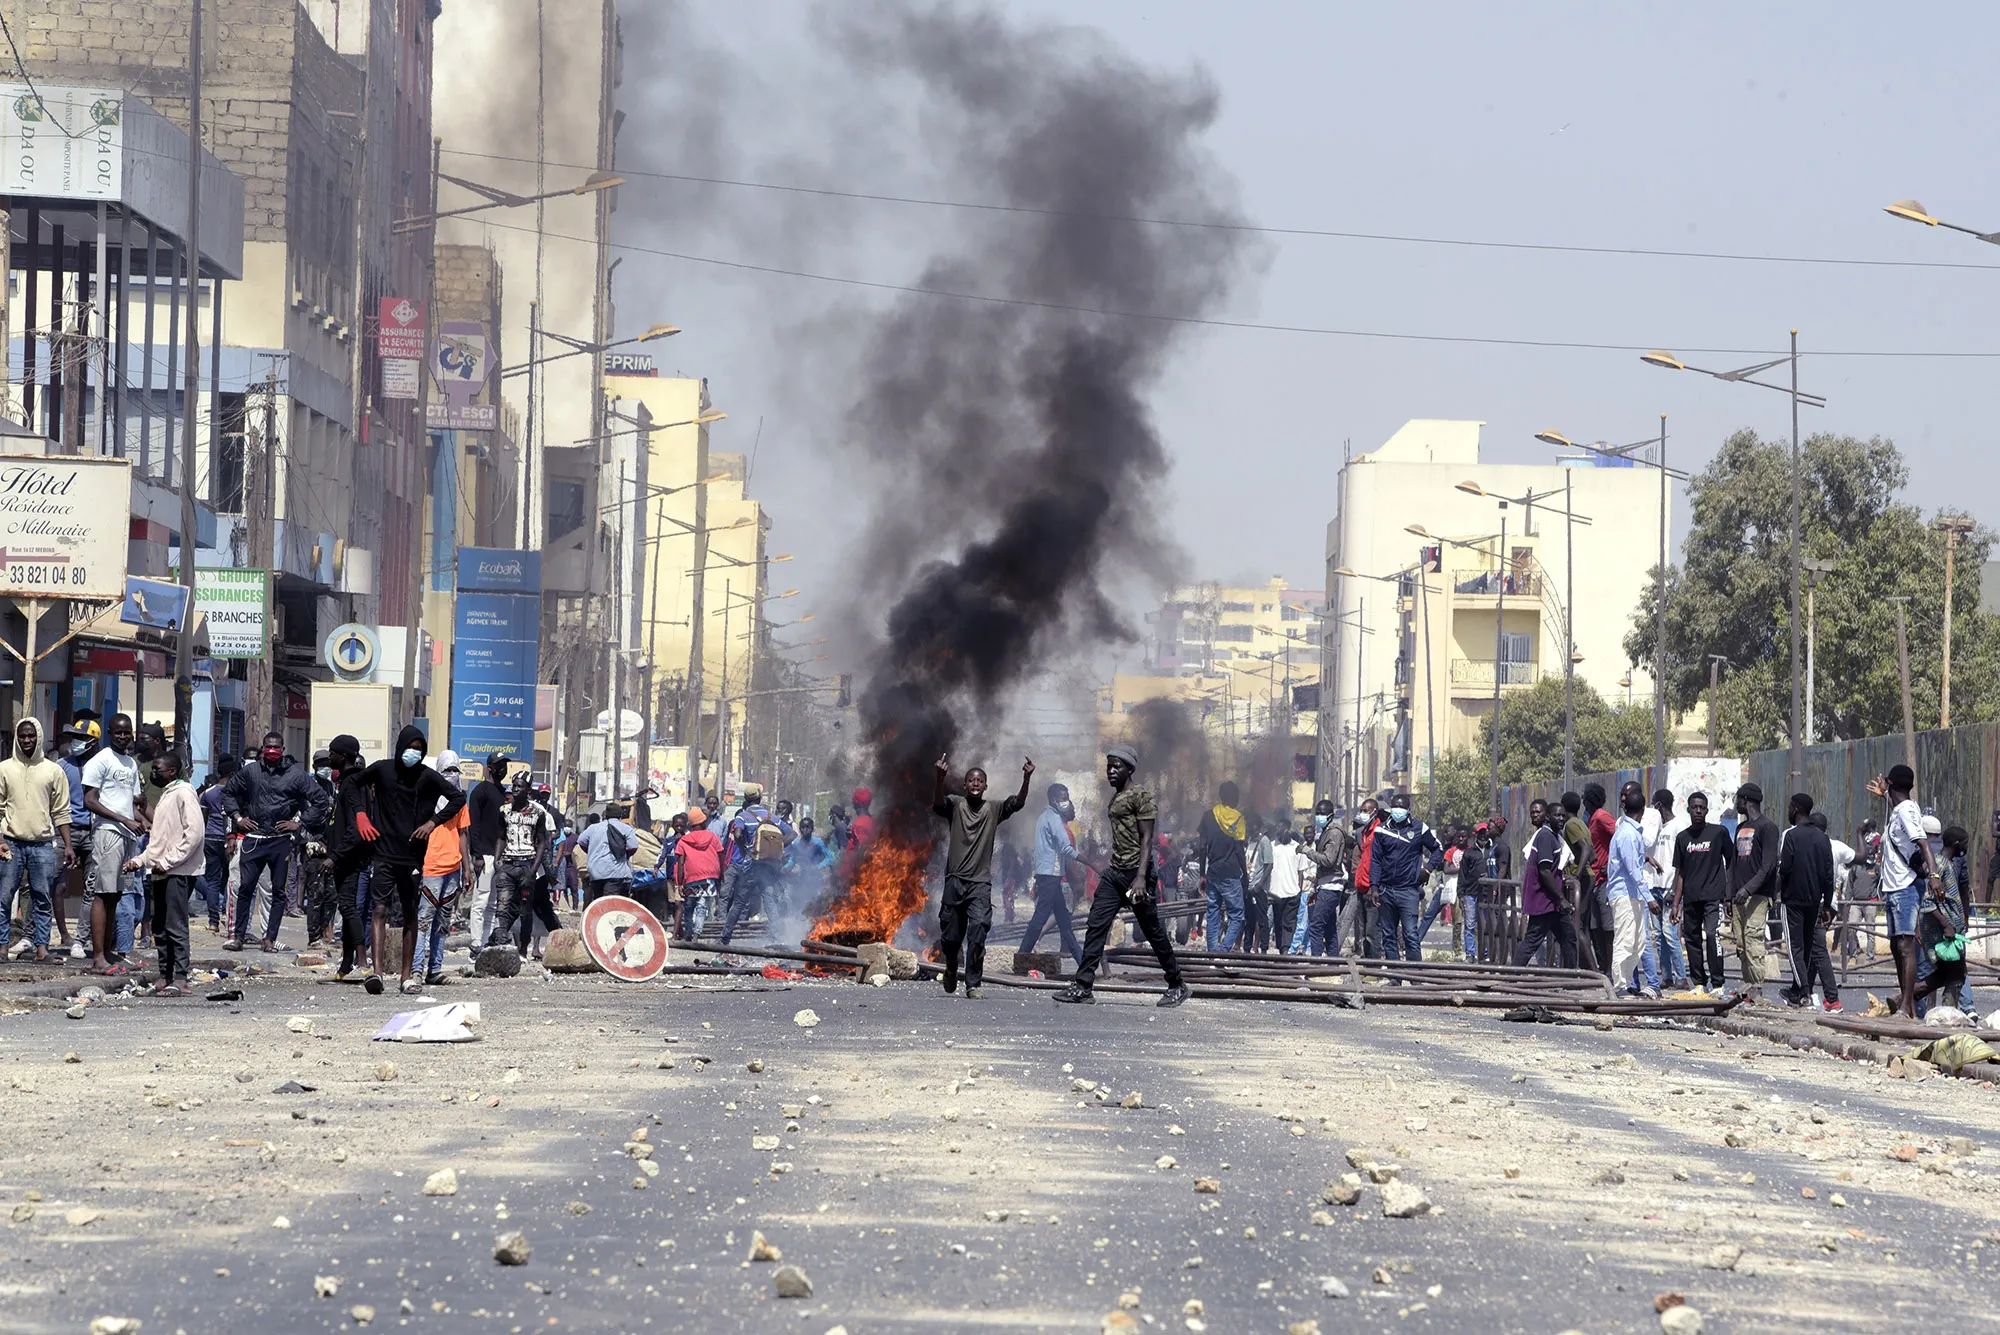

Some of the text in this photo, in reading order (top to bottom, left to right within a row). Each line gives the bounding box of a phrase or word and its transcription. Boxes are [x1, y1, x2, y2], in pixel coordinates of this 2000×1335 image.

[380, 337, 389, 346] LA
[605, 355, 652, 371] EPRIM
[462, 407, 494, 419] ESCI
[0, 467, 77, 496] Hôtel
[0, 494, 74, 516] Résidence
[478, 560, 522, 576] Ecobank
[10, 565, 87, 586] 33 821 04 80
[218, 571, 264, 583] GROUPE
[195, 588, 263, 602] SSURANCES
[212, 611, 262, 624] BRANCHES
[493, 696, 524, 706] 24H GAB
[464, 743, 518, 755] Rapidtransfer
